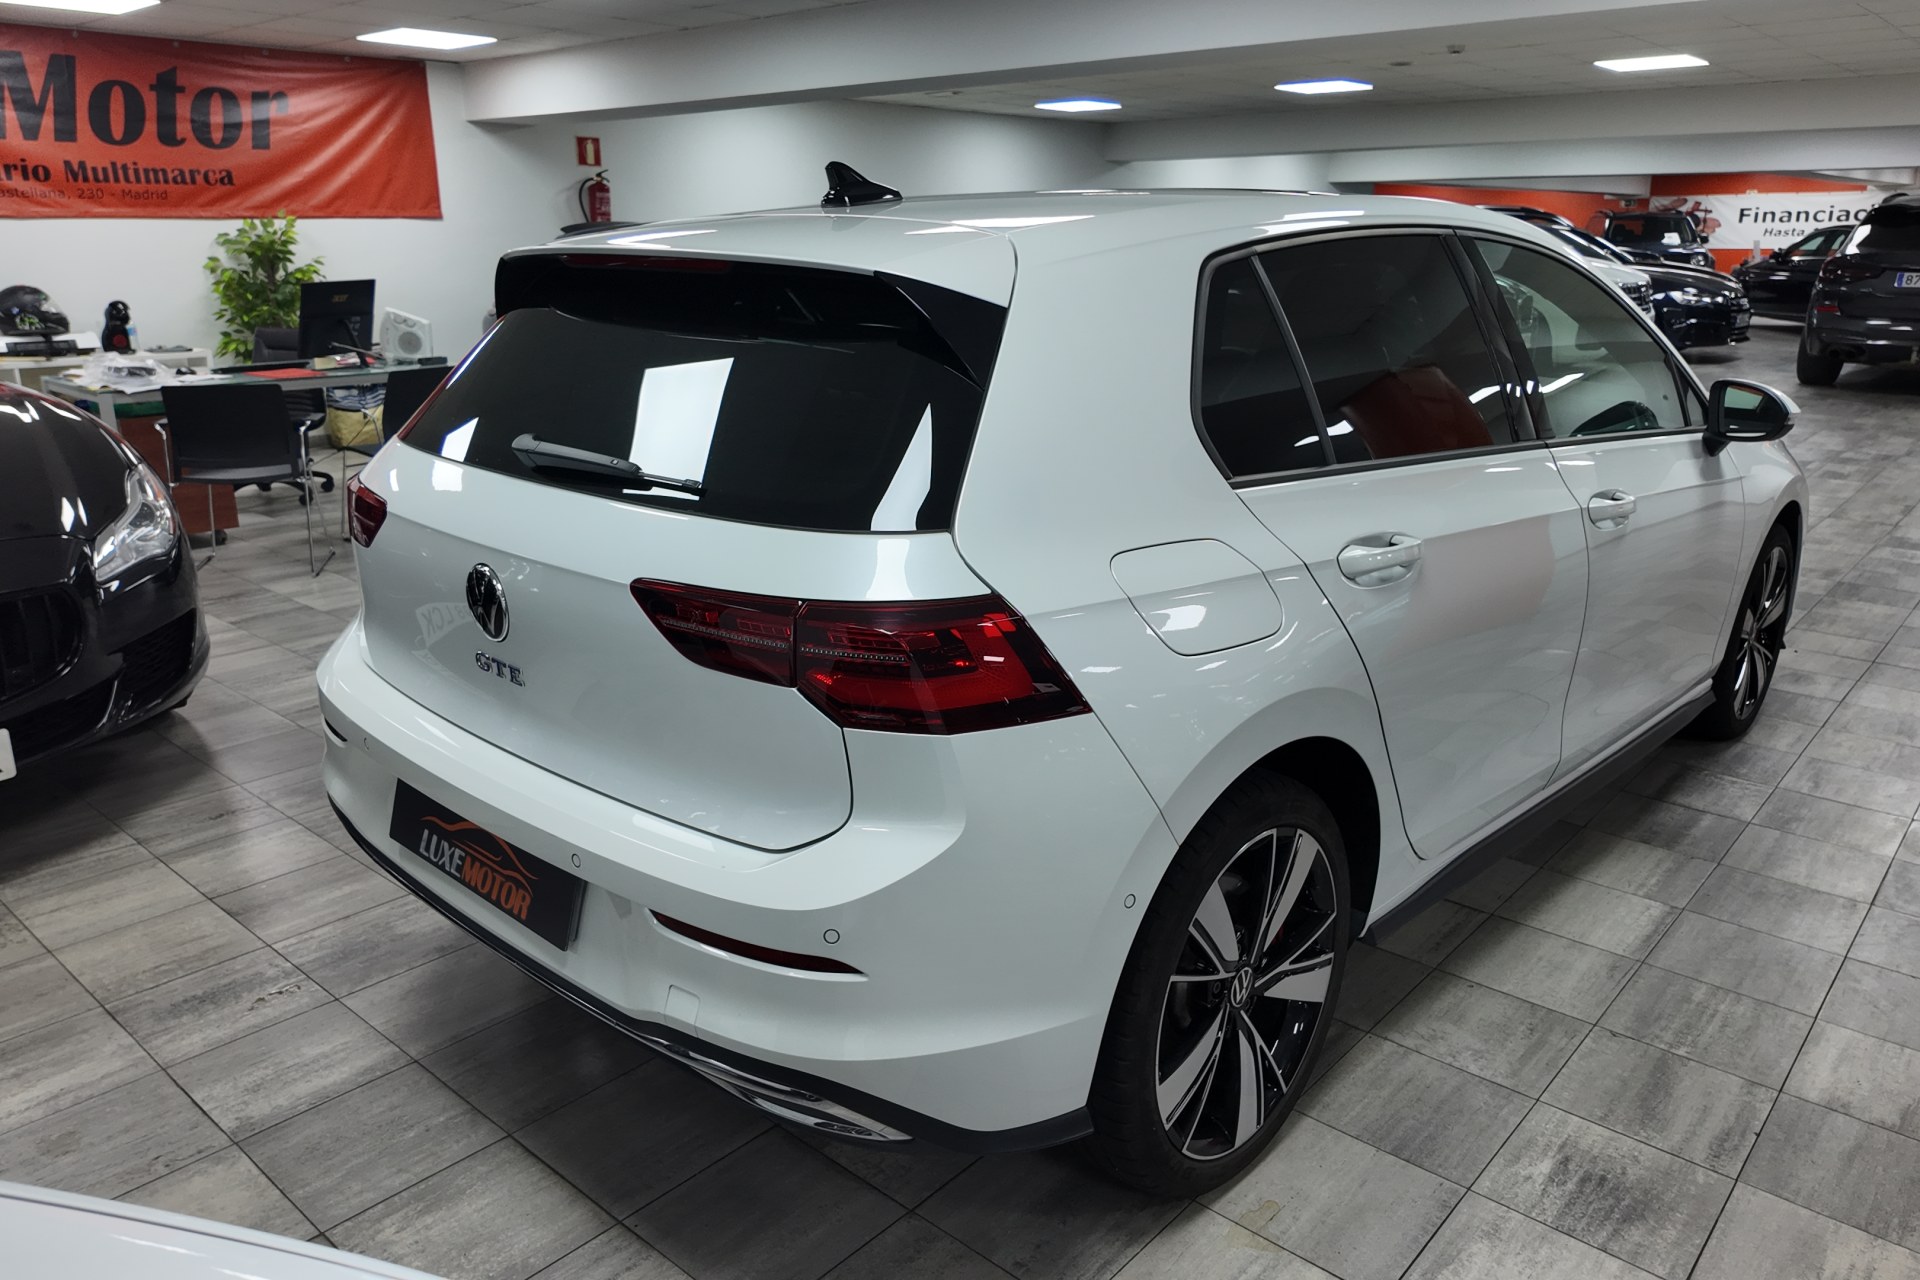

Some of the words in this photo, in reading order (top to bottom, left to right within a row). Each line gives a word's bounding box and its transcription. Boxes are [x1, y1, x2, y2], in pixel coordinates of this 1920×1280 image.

[0, 158, 52, 183] rio
[63, 159, 236, 187] Multimarca
[77, 188, 105, 200] 230
[122, 189, 168, 201] Madrid
[1738, 204, 1879, 224] Financiac
[1763, 226, 1806, 238] Hasta
[475, 650, 526, 687] GTE
[419, 828, 533, 921] LUXEMOTOR
